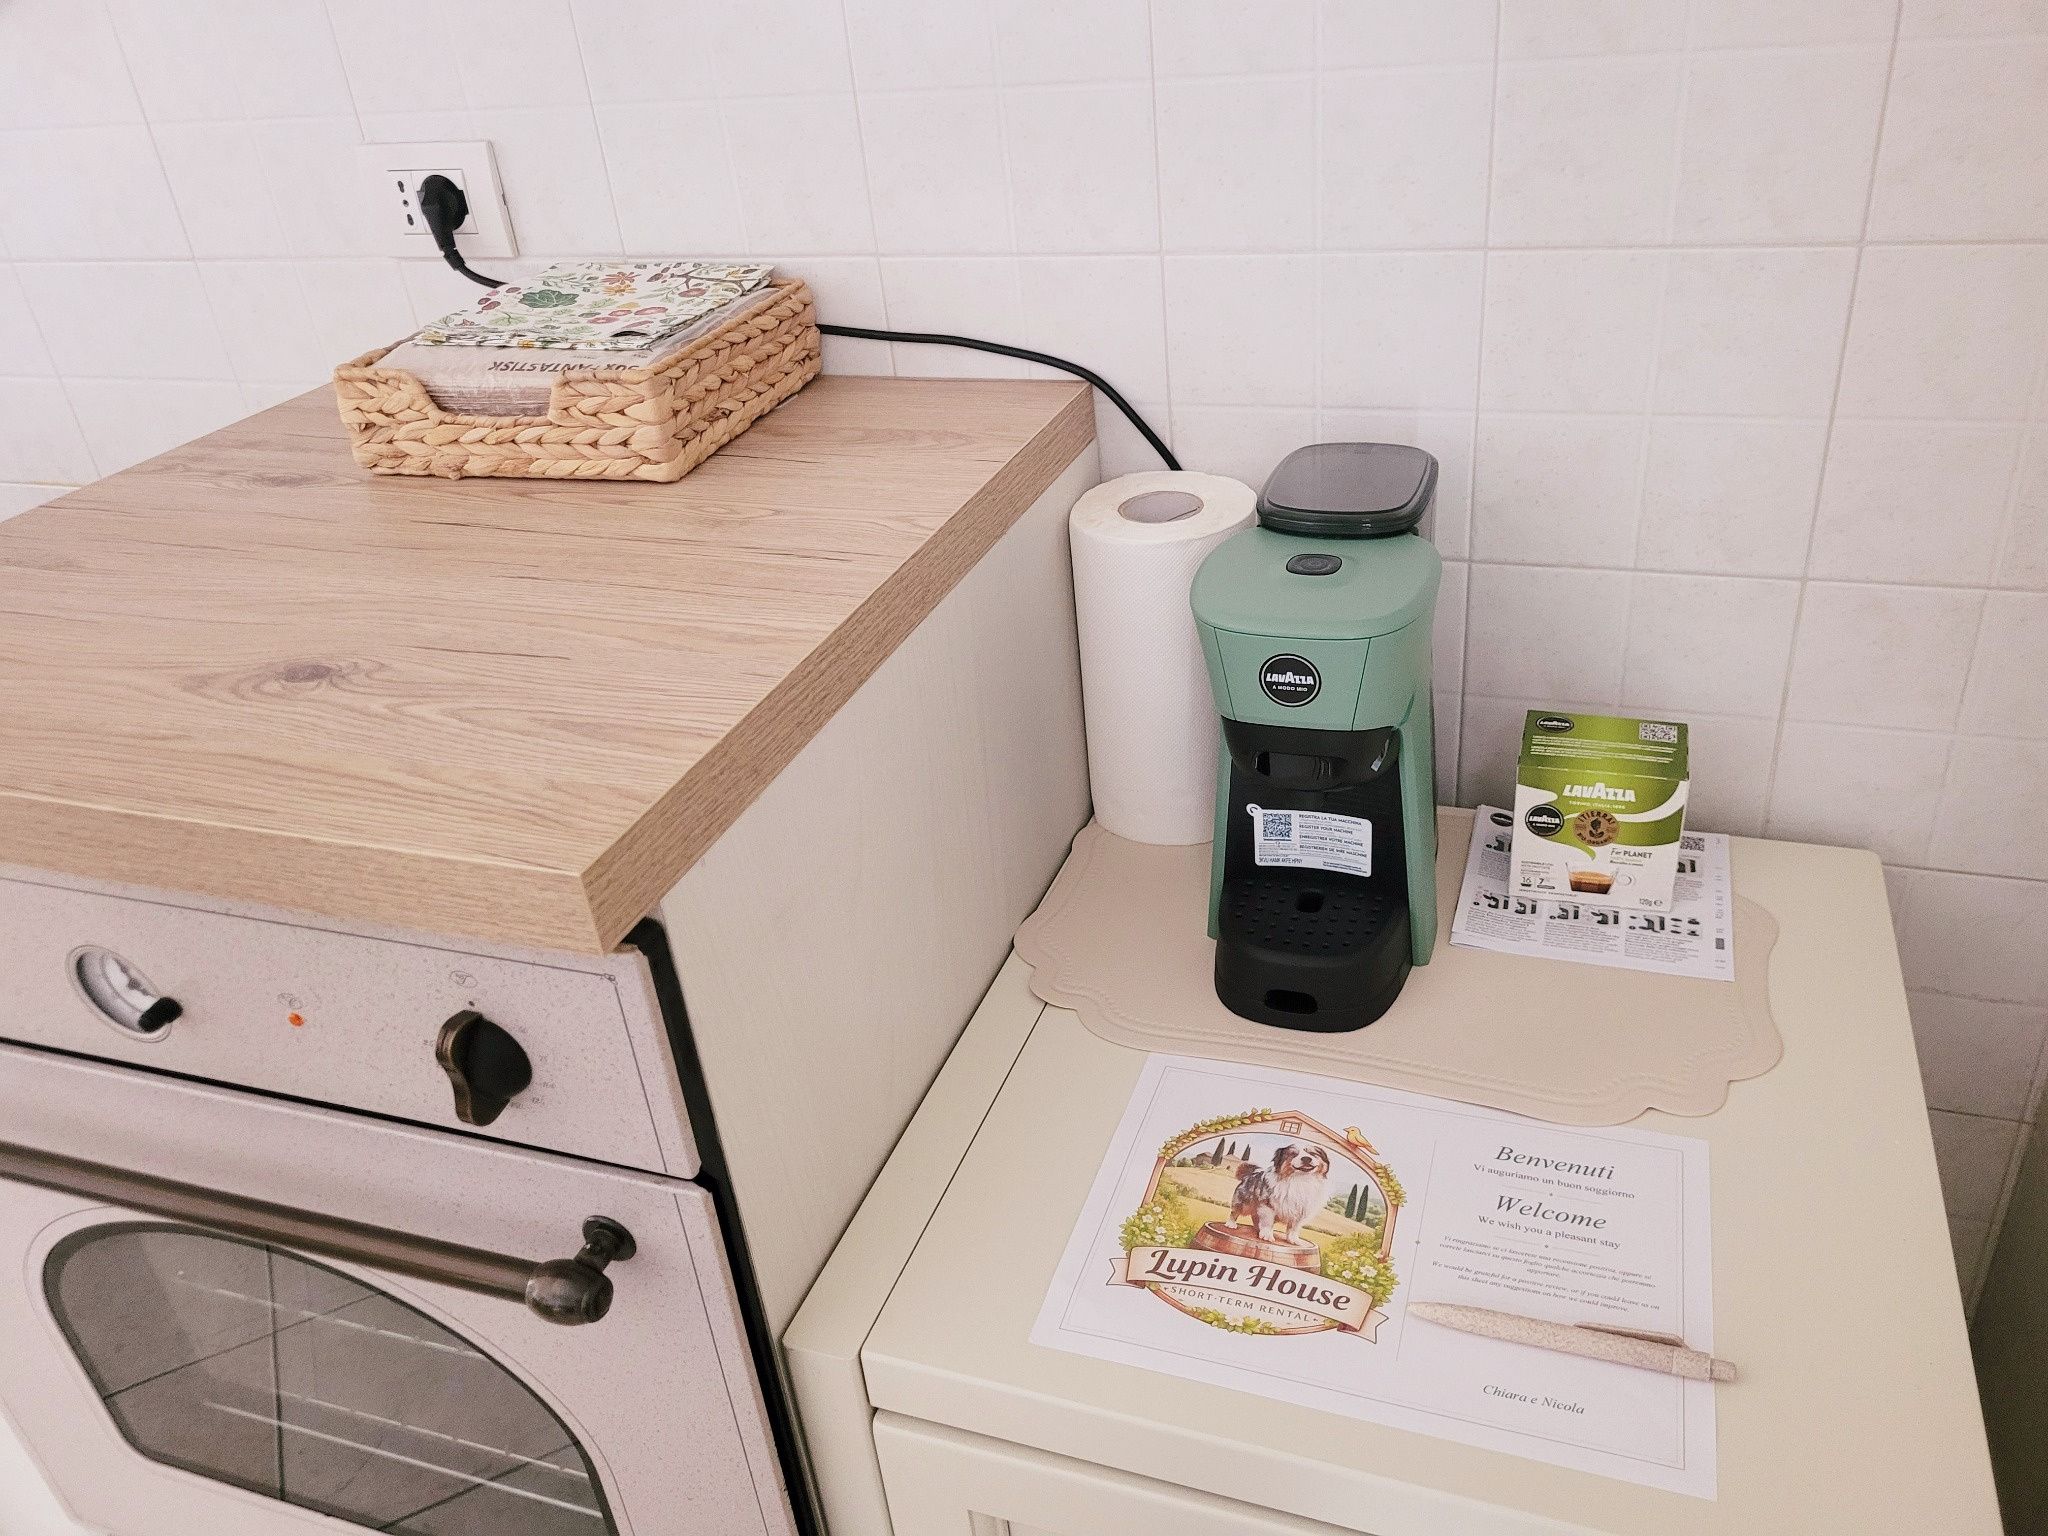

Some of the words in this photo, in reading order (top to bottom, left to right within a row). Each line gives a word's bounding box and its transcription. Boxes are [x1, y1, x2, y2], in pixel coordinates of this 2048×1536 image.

[1266, 671, 1315, 685] LAVAZZA
[1562, 782, 1636, 802] LAVAZZA
[1623, 850, 1653, 859] PLANET
[1494, 1145, 1615, 1180] Benvenuti
[1473, 1163, 1485, 1172] Vi
[1487, 1167, 1540, 1183] auguriamo
[1541, 1177, 1555, 1185] un
[1557, 1179, 1582, 1191] buon
[1584, 1185, 1635, 1199] soggiorno
[1496, 1194, 1608, 1230] Welcome
[1478, 1215, 1495, 1225] We
[1498, 1219, 1521, 1231] wish
[1523, 1225, 1543, 1235] you
[1554, 1230, 1597, 1245] pleasant
[1599, 1238, 1621, 1250] stay
[1145, 1249, 1238, 1282] Lupin
[1245, 1265, 1352, 1311] House
[1259, 1304, 1310, 1322] RENTAL
[1483, 1384, 1528, 1402] Chiara
[1530, 1396, 1538, 1404] e
[1541, 1396, 1585, 1415] Nicola
